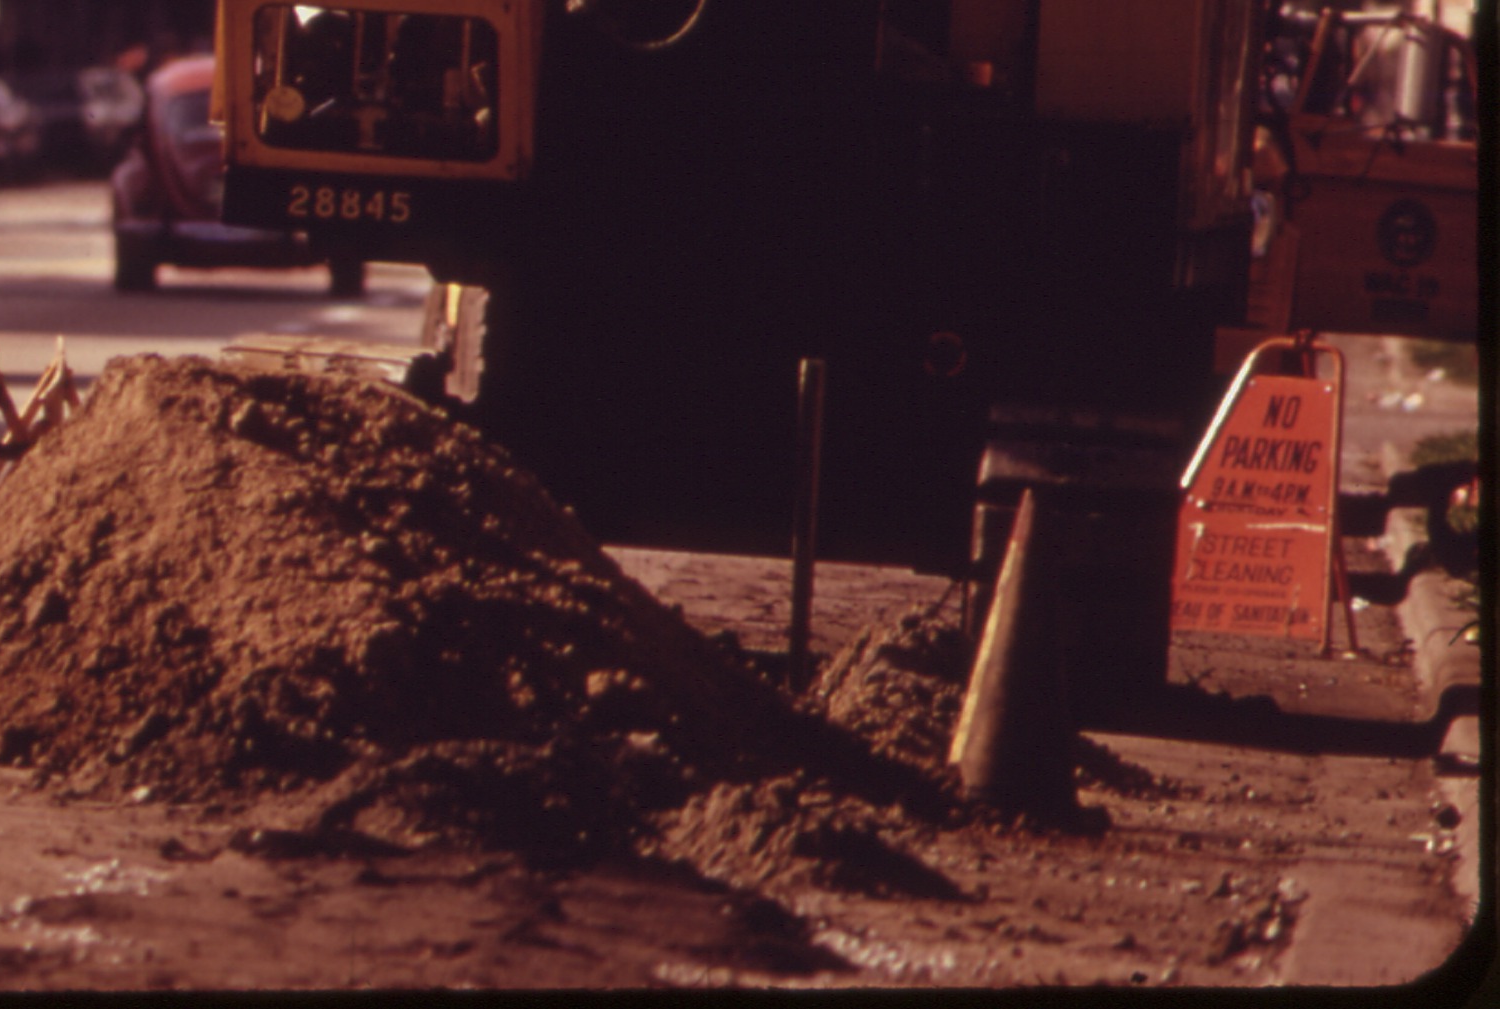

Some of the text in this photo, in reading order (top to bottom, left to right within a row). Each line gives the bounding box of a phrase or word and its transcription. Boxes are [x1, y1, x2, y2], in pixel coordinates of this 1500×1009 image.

[287, 184, 412, 223] 28845
[1263, 394, 1302, 429] NO
[1219, 435, 1323, 474] PARKING
[1201, 533, 1295, 559] STREET
[1232, 603, 1309, 625] SANITATON
